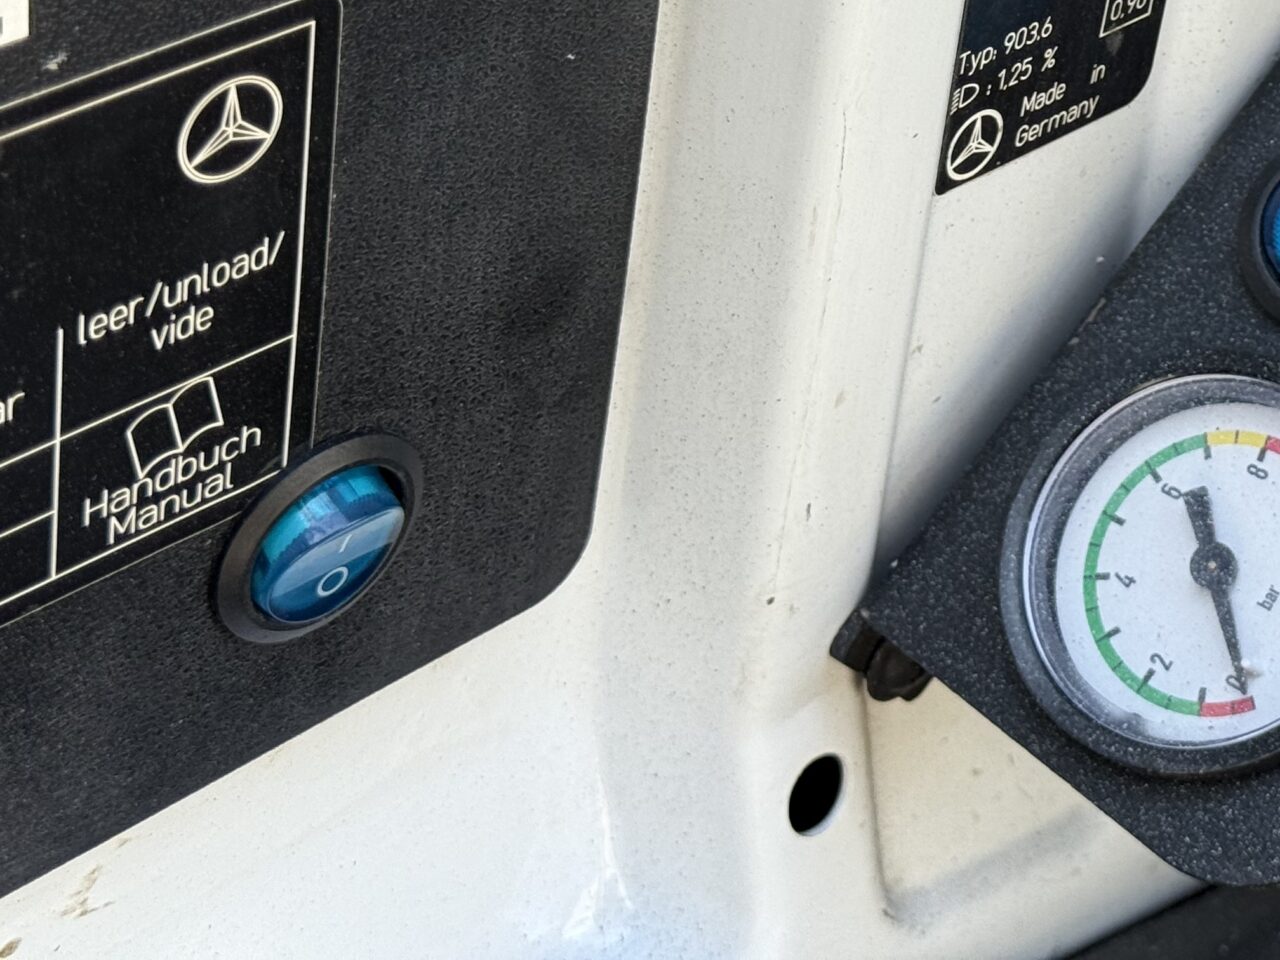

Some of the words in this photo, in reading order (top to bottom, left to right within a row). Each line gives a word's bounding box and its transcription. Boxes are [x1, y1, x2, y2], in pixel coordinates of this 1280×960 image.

[960, 46, 997, 76] Typ:
[1041, 46, 1058, 72] %
[1020, 81, 1066, 117] Made
[1089, 64, 1106, 84] in
[1015, 95, 1100, 147] Germany
[151, 305, 214, 350] vide
[82, 425, 261, 527] Handbuch
[1246, 464, 1269, 480] 8
[108, 462, 234, 545] Manual
[1160, 482, 1183, 501] 6
[1114, 572, 1136, 588] 4
[1256, 584, 1280, 611] bar
[1150, 653, 1173, 671] 2
